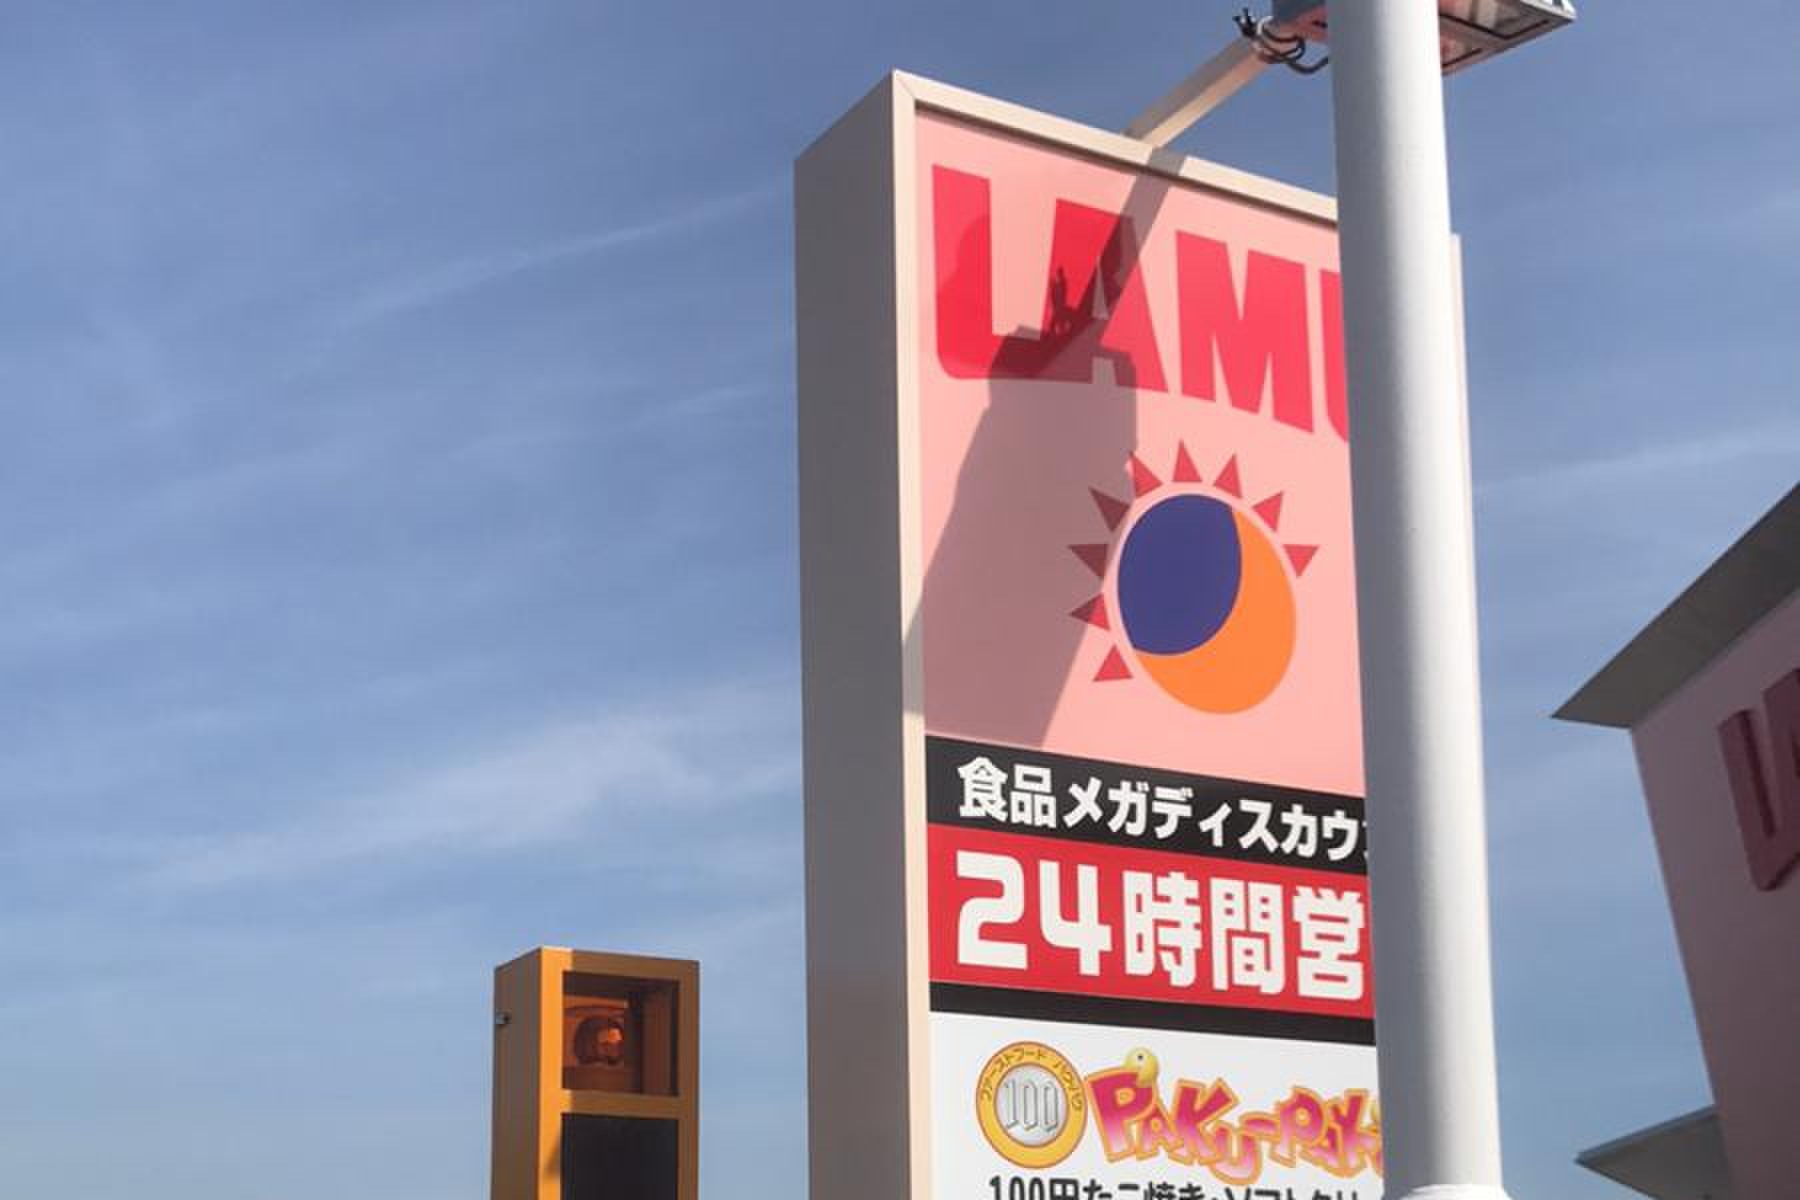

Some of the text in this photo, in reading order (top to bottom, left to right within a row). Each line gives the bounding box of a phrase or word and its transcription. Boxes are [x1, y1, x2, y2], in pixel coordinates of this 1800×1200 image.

[957, 756, 1368, 861] 食品メガディスカウ
[956, 850, 1365, 1001] 24時間営
[1002, 1078, 1060, 1133] 100
